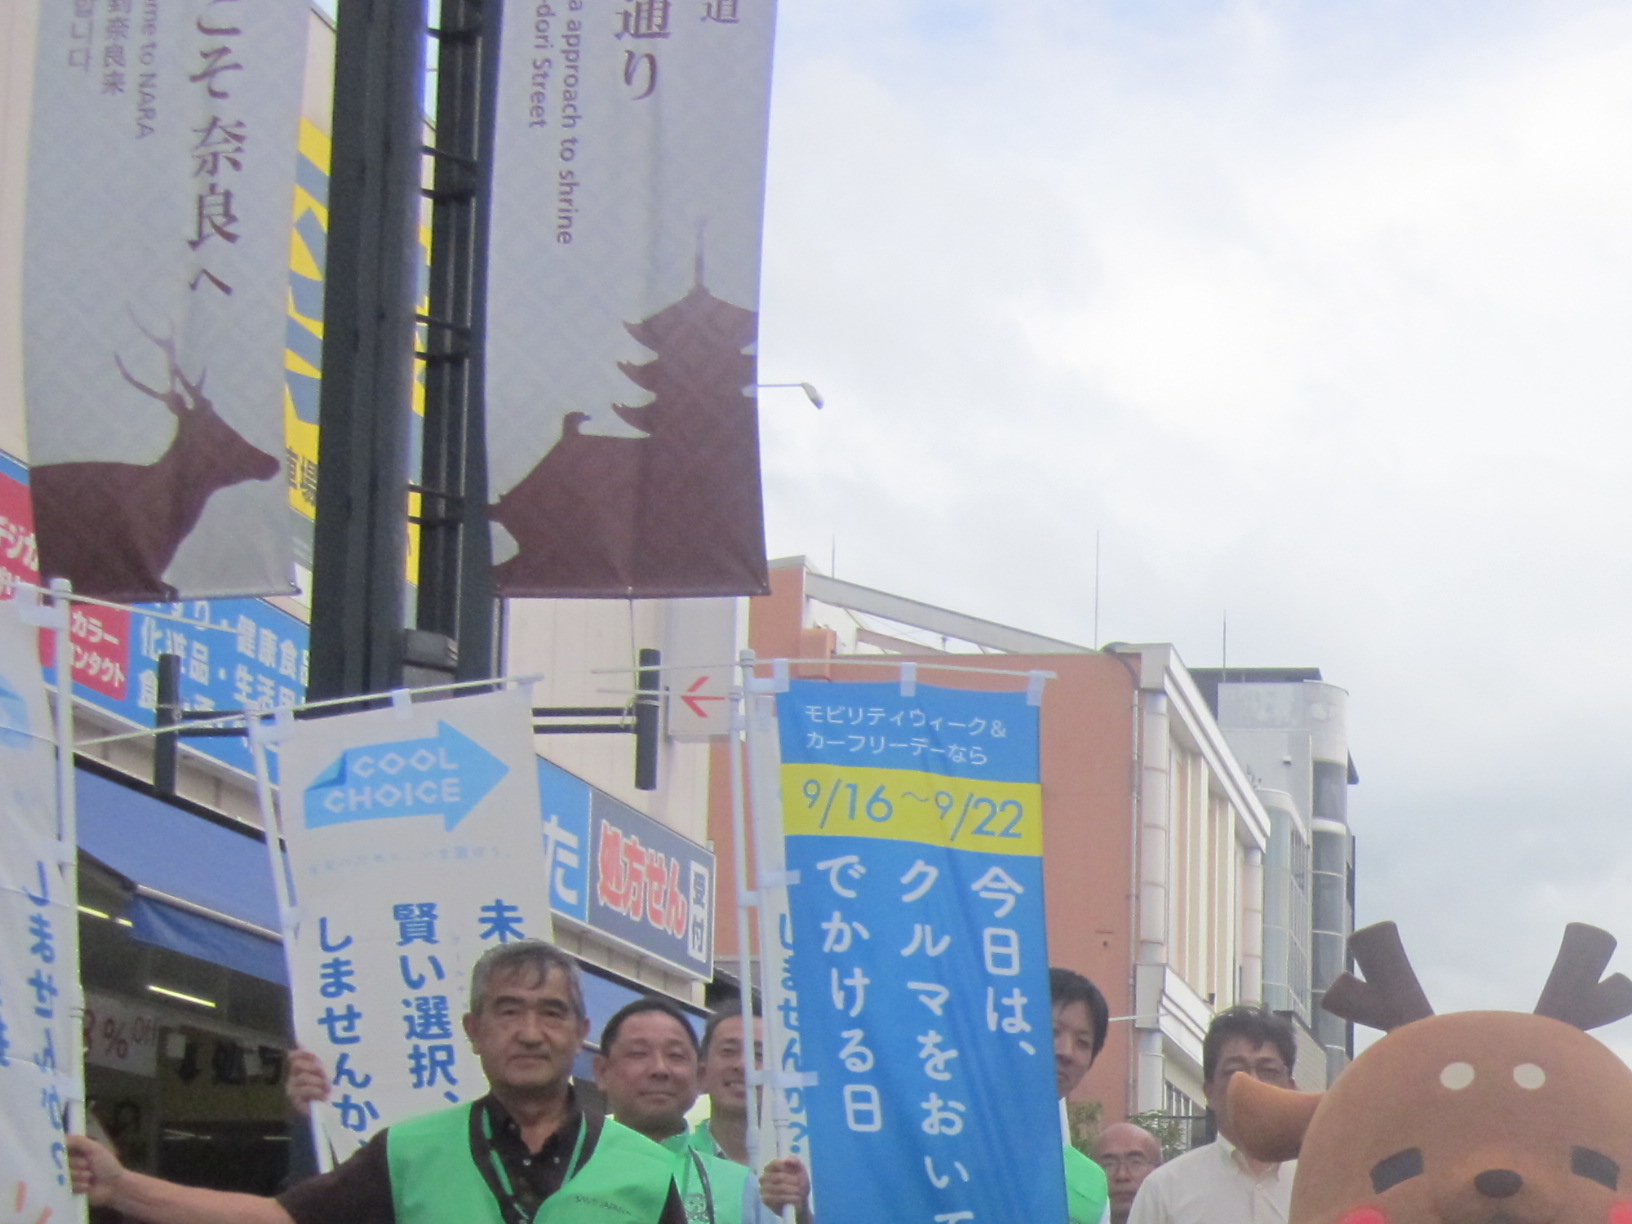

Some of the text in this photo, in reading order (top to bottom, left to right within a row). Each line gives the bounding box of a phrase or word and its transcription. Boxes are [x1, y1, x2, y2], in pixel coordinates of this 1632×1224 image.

[135, 72, 158, 140] NARA
[528, 57, 553, 129] Street
[560, 19, 583, 129] approach
[559, 136, 579, 163] to
[556, 169, 581, 245] shrine
[71, 609, 120, 647] カラー
[70, 642, 126, 689] ンタクト
[352, 747, 459, 778] COOL
[806, 731, 988, 765] カーフリーデーなら
[323, 778, 461, 813] CHOICE
[598, 818, 688, 940] 処方せん
[816, 854, 882, 1132] でかける日
[970, 866, 1035, 1056] 今日は、
[392, 902, 460, 1103] 賢い選択、
